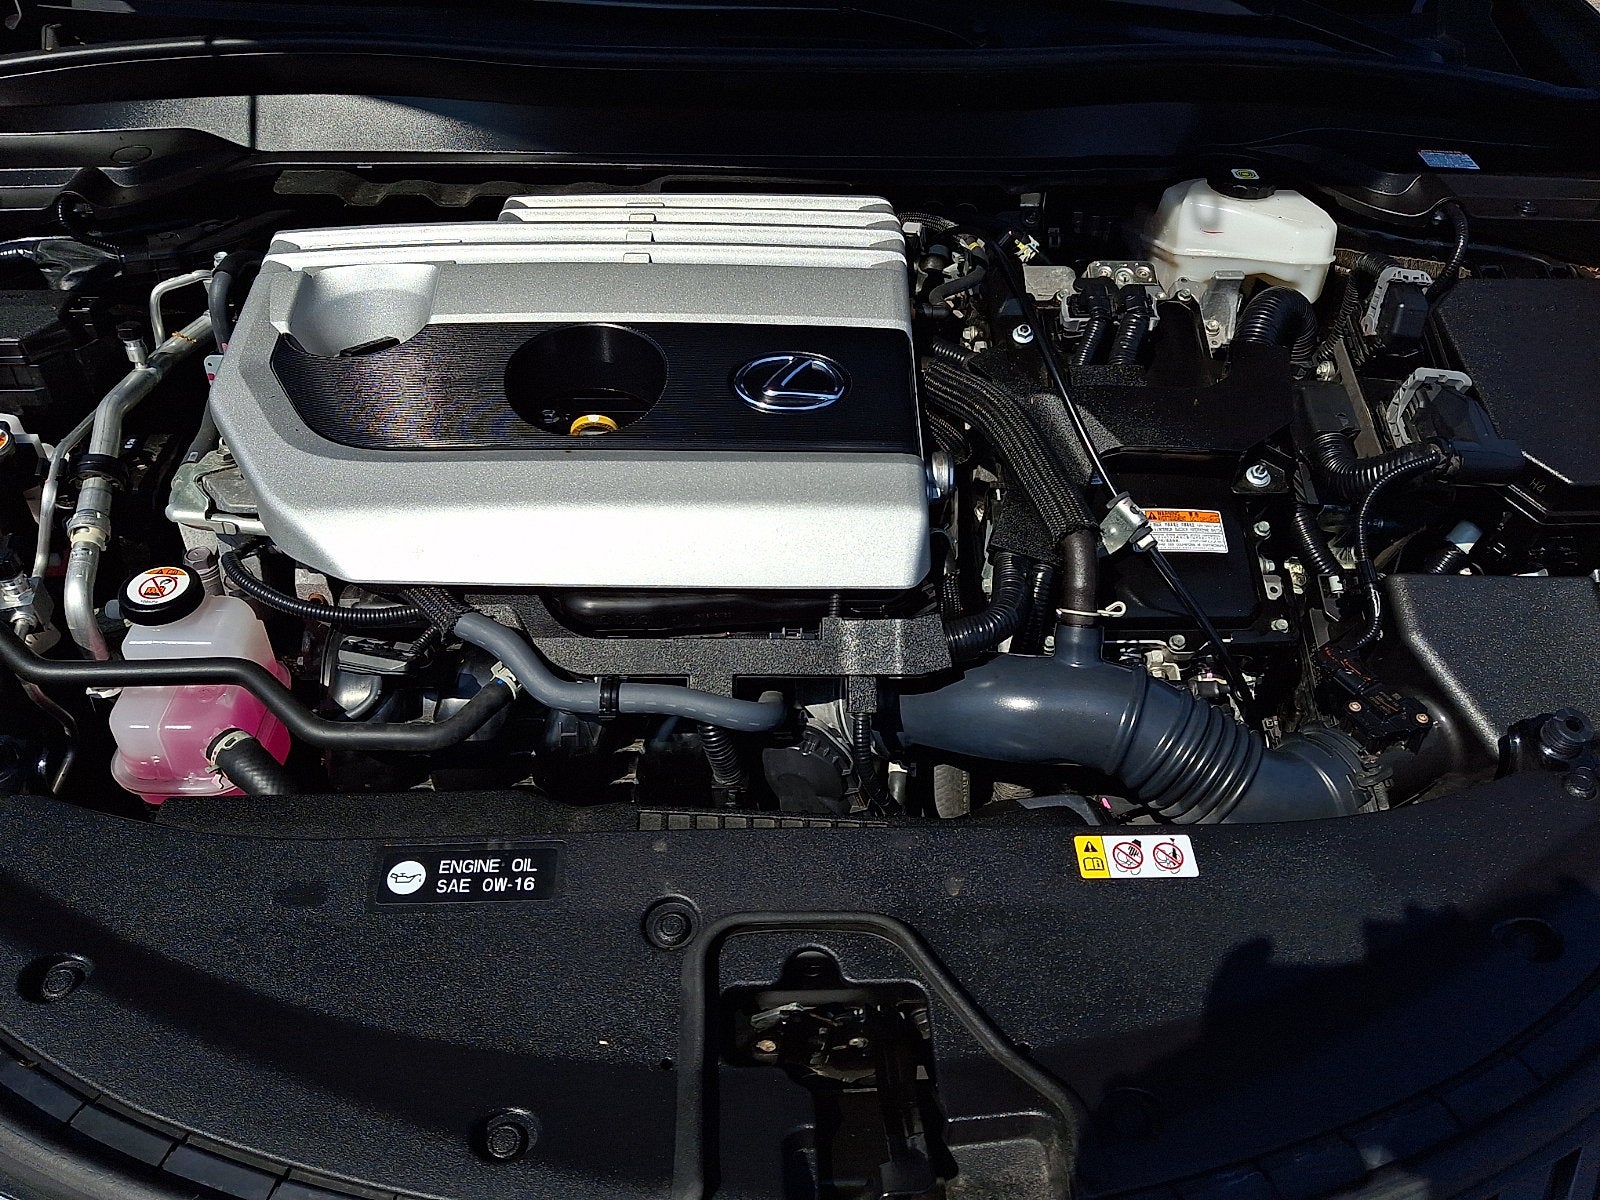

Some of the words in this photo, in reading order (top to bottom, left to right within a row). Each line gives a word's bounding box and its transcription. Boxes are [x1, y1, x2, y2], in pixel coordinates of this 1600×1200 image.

[438, 859, 501, 874] ENGINE
[511, 858, 538, 872] OIL
[436, 878, 472, 893] SAE
[482, 877, 536, 892] 0W-16
